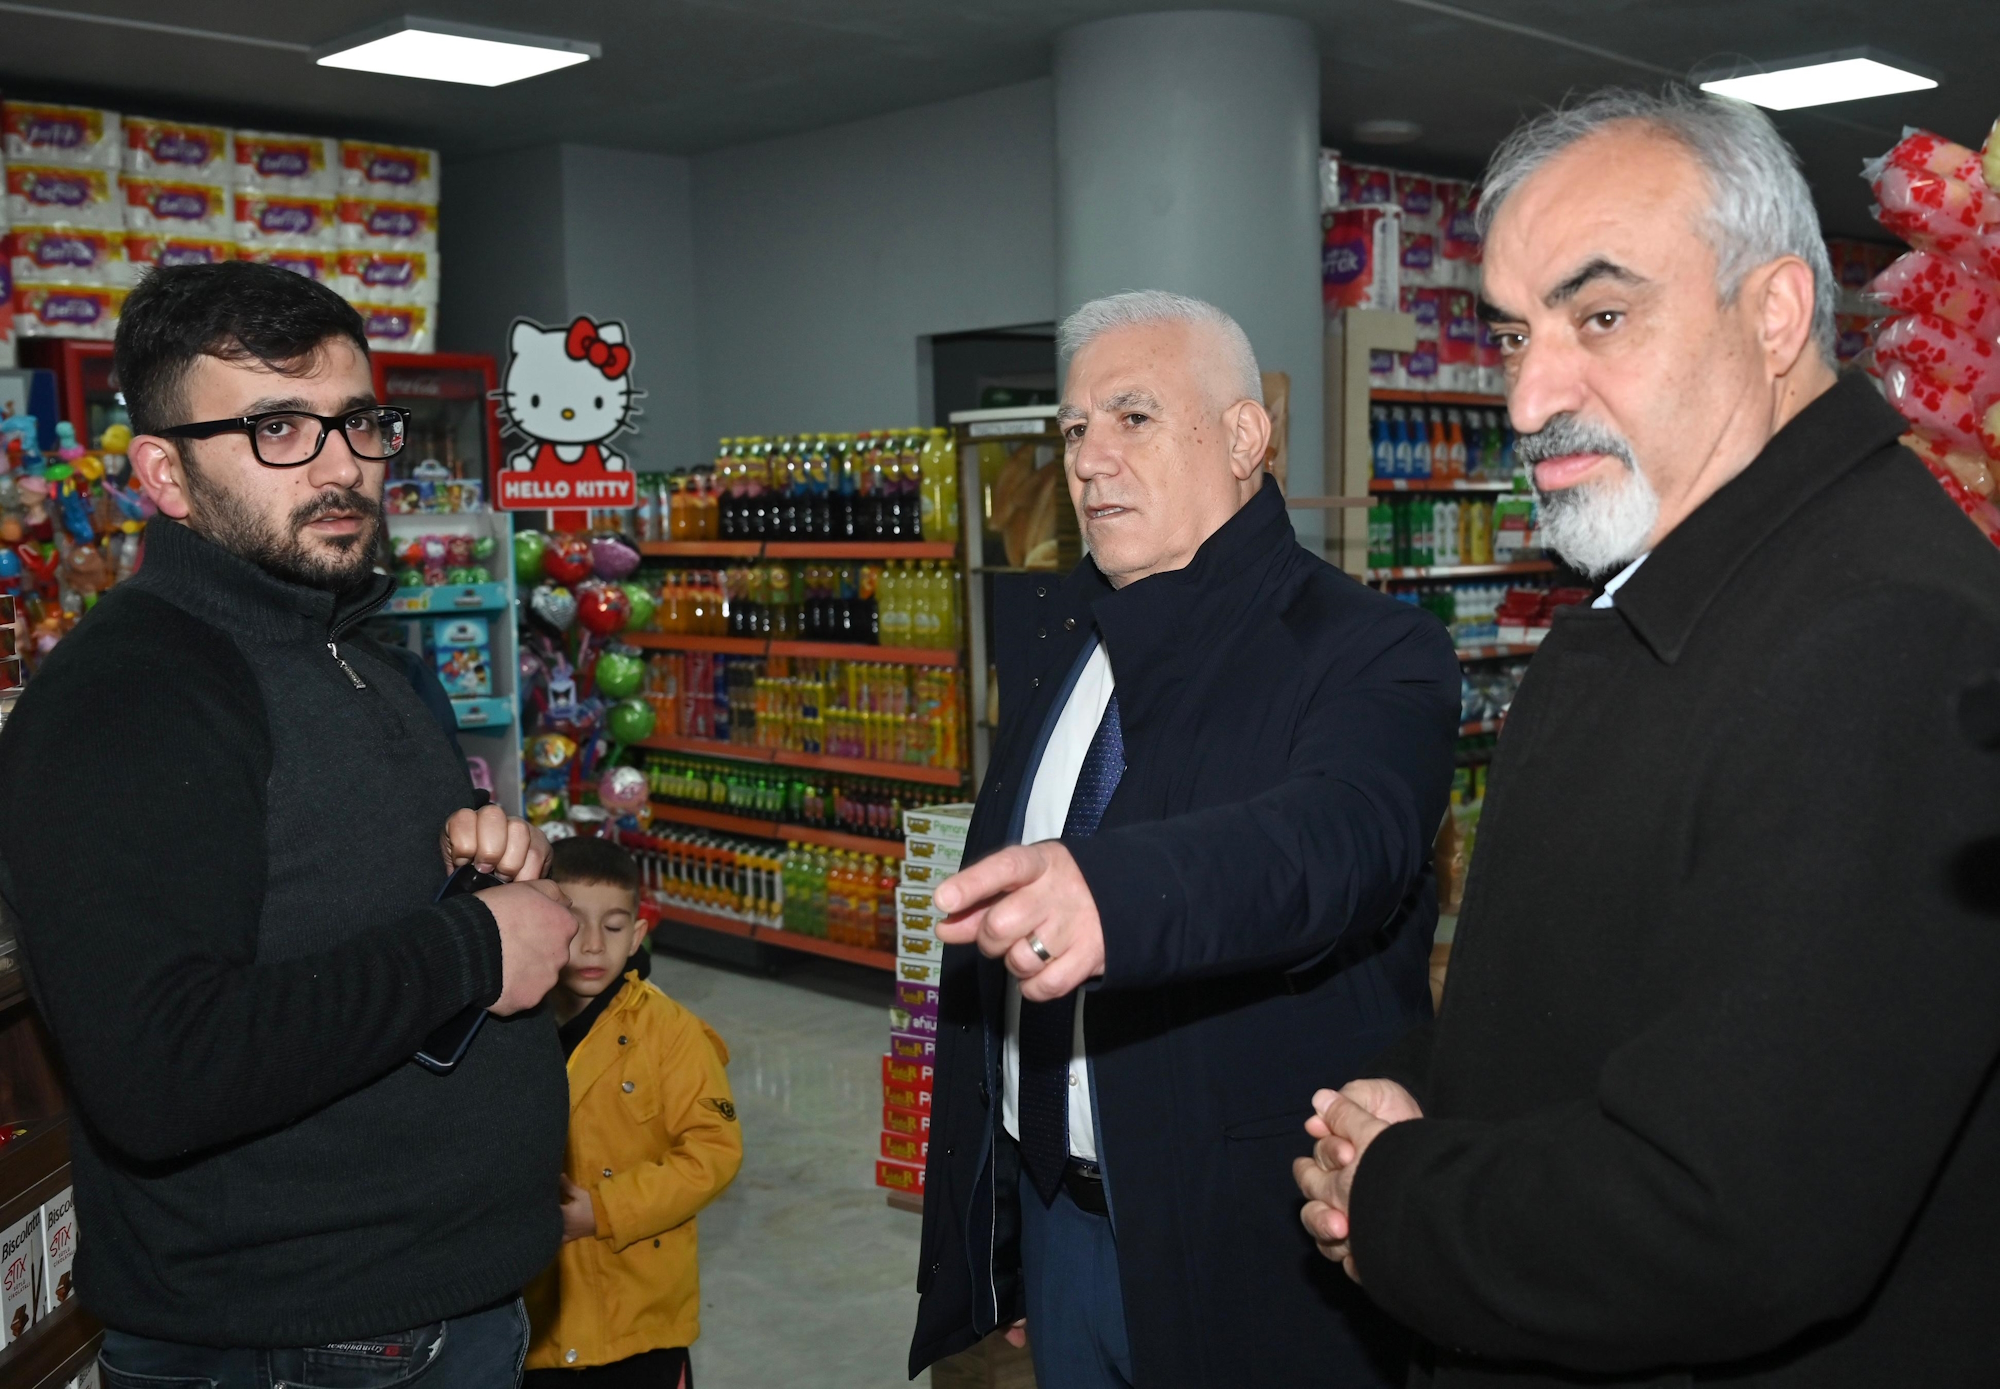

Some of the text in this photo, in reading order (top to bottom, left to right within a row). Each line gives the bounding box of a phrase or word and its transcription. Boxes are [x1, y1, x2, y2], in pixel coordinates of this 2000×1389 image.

[505, 480, 630, 499] HELLO KITTY
[49, 1222, 72, 1257] STIX
[3, 1253, 27, 1291] STIX
